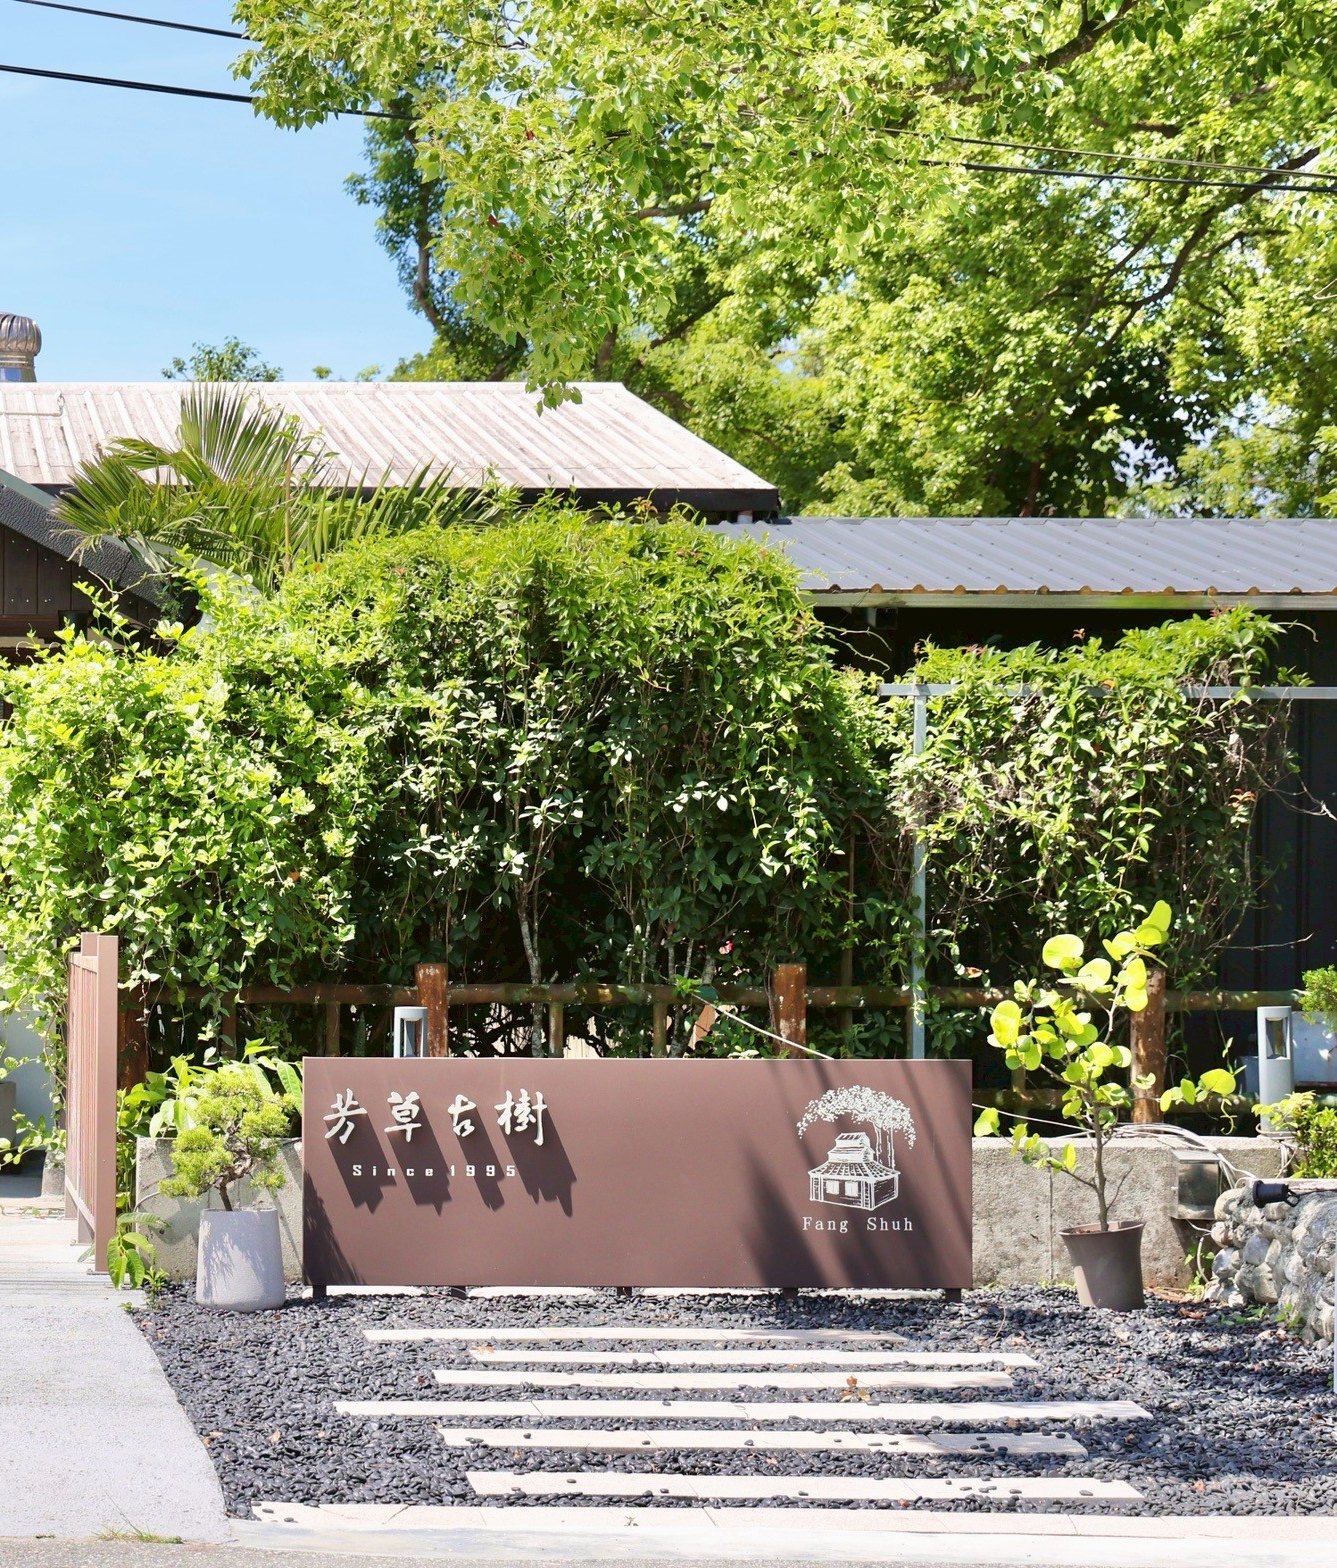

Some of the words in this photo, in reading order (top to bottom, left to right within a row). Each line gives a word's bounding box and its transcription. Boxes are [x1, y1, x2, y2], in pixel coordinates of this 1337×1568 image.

[323, 1088, 548, 1147] 芳草古樹
[352, 1164, 434, 1177] Since
[450, 1164, 516, 1177] 1995
[802, 1216, 849, 1234] Fang
[866, 1216, 914, 1231] Shuh
